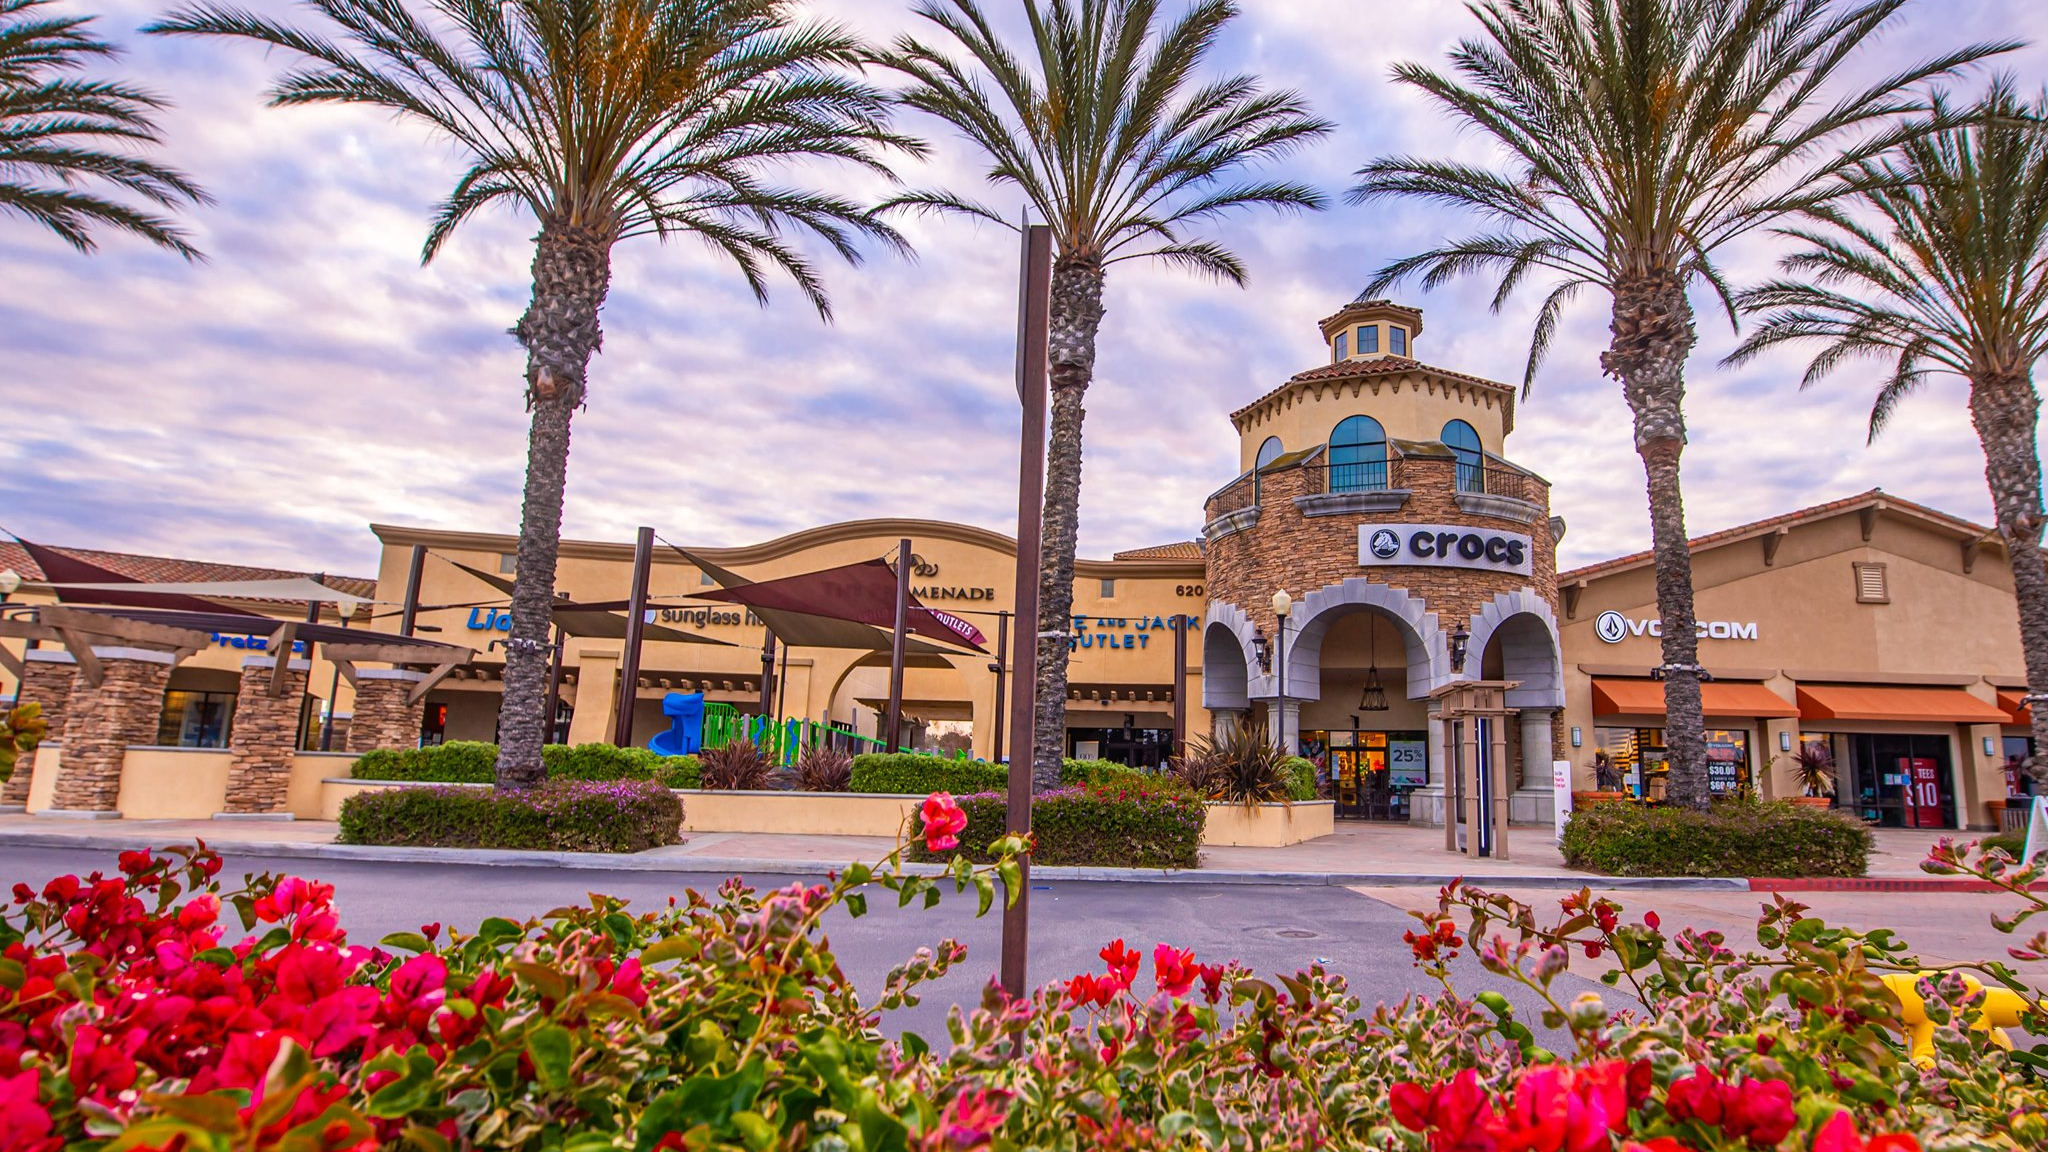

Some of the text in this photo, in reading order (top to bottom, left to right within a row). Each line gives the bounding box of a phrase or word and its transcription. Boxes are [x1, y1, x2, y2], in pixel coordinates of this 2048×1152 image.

[1409, 530, 1525, 566] crocs
[1175, 584, 1204, 597] 620
[661, 606, 741, 628] sunglass
[936, 612, 974, 636] OUTLETS
[1097, 618, 1127, 629] AND
[1627, 619, 1758, 640] VOCOM
[1393, 749, 1423, 763] 25%
[1709, 766, 1736, 775] $30.00
[1918, 769, 1935, 779] TEES
